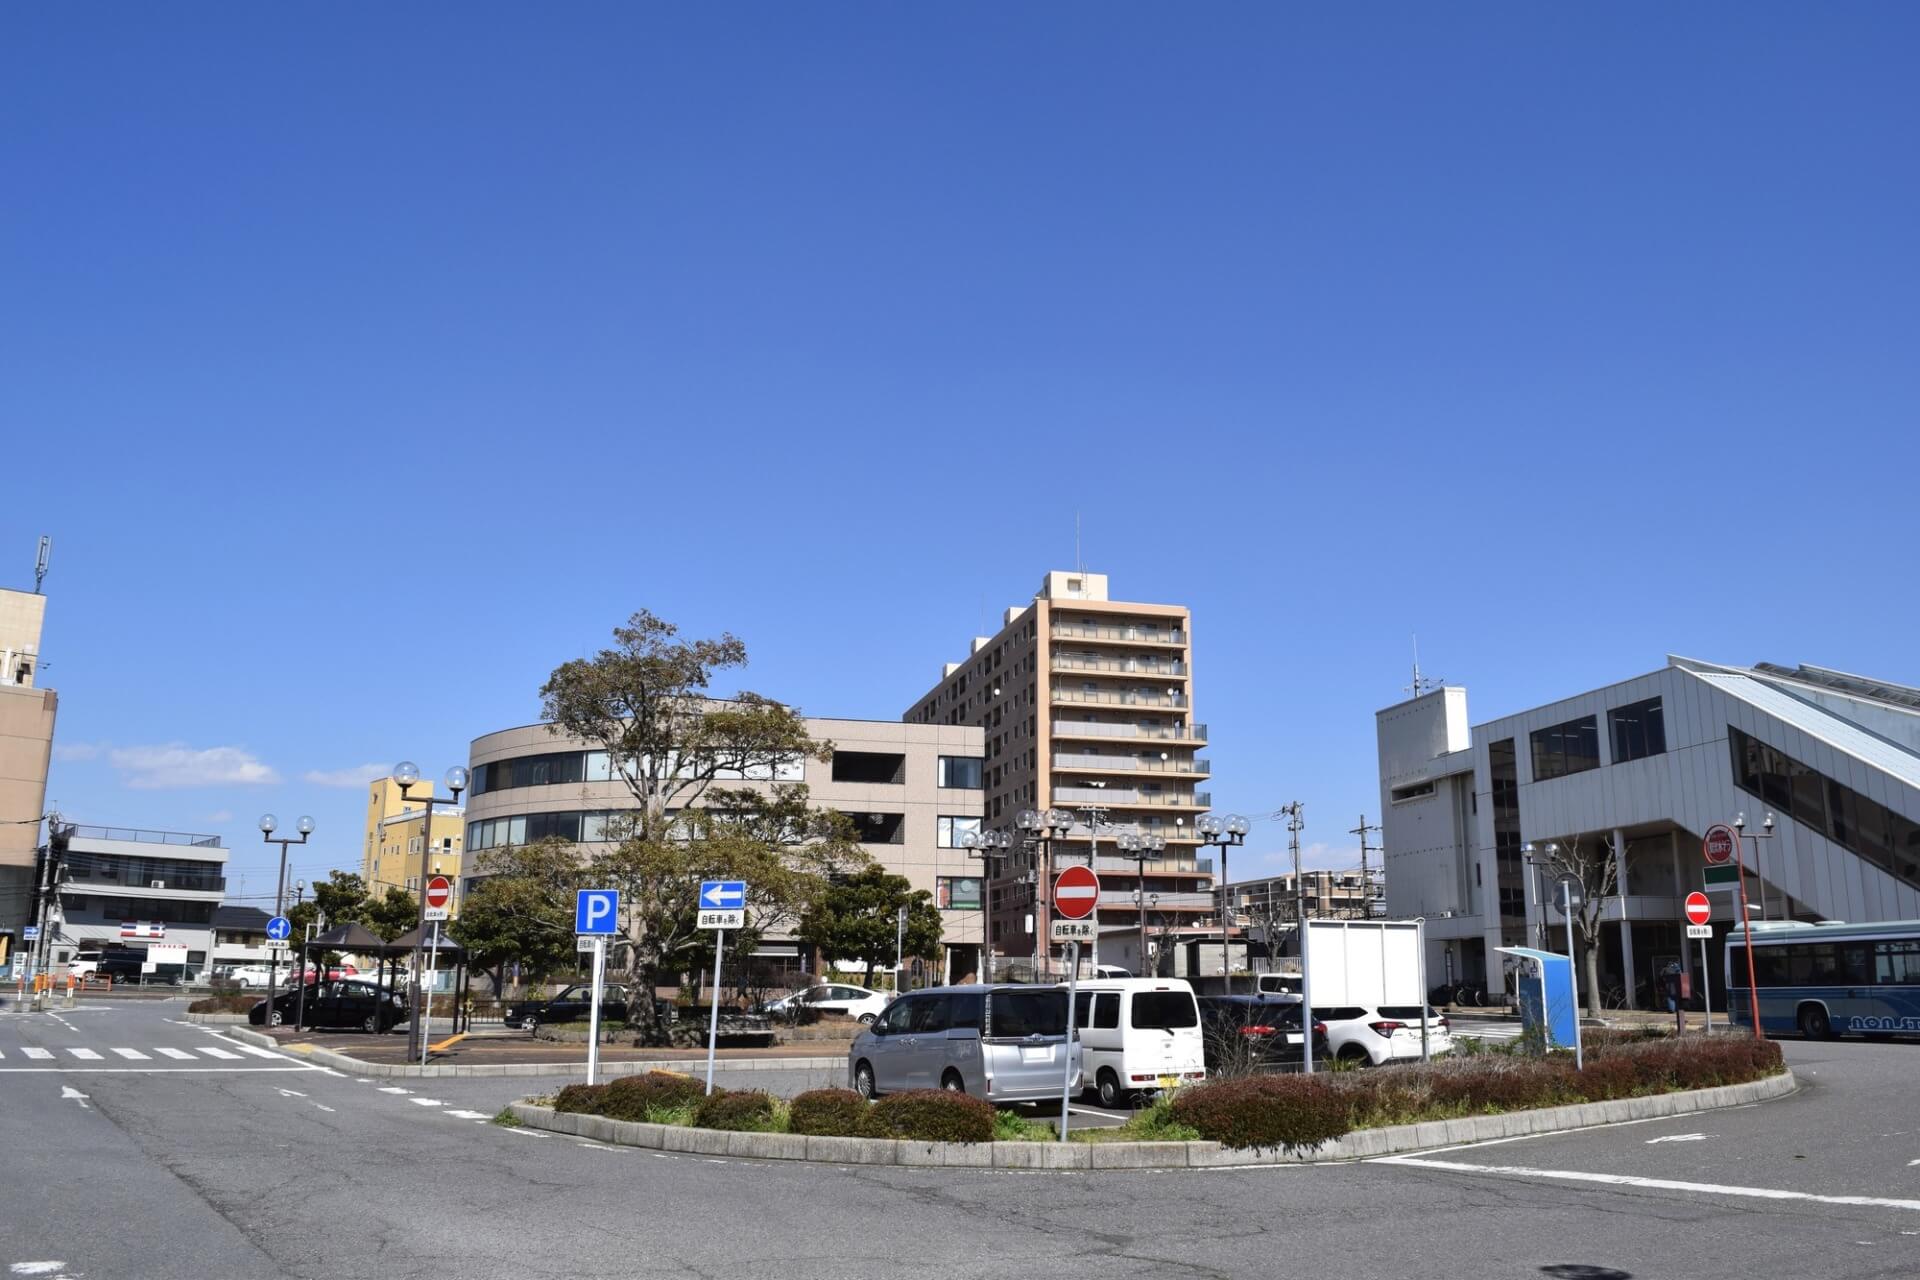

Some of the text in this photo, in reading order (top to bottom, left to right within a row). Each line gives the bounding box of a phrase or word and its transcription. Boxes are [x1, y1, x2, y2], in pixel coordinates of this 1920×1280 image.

[587, 894, 611, 929] P
[702, 914, 740, 925] 自転車を除く
[1055, 924, 1094, 936] 自転車を除く
